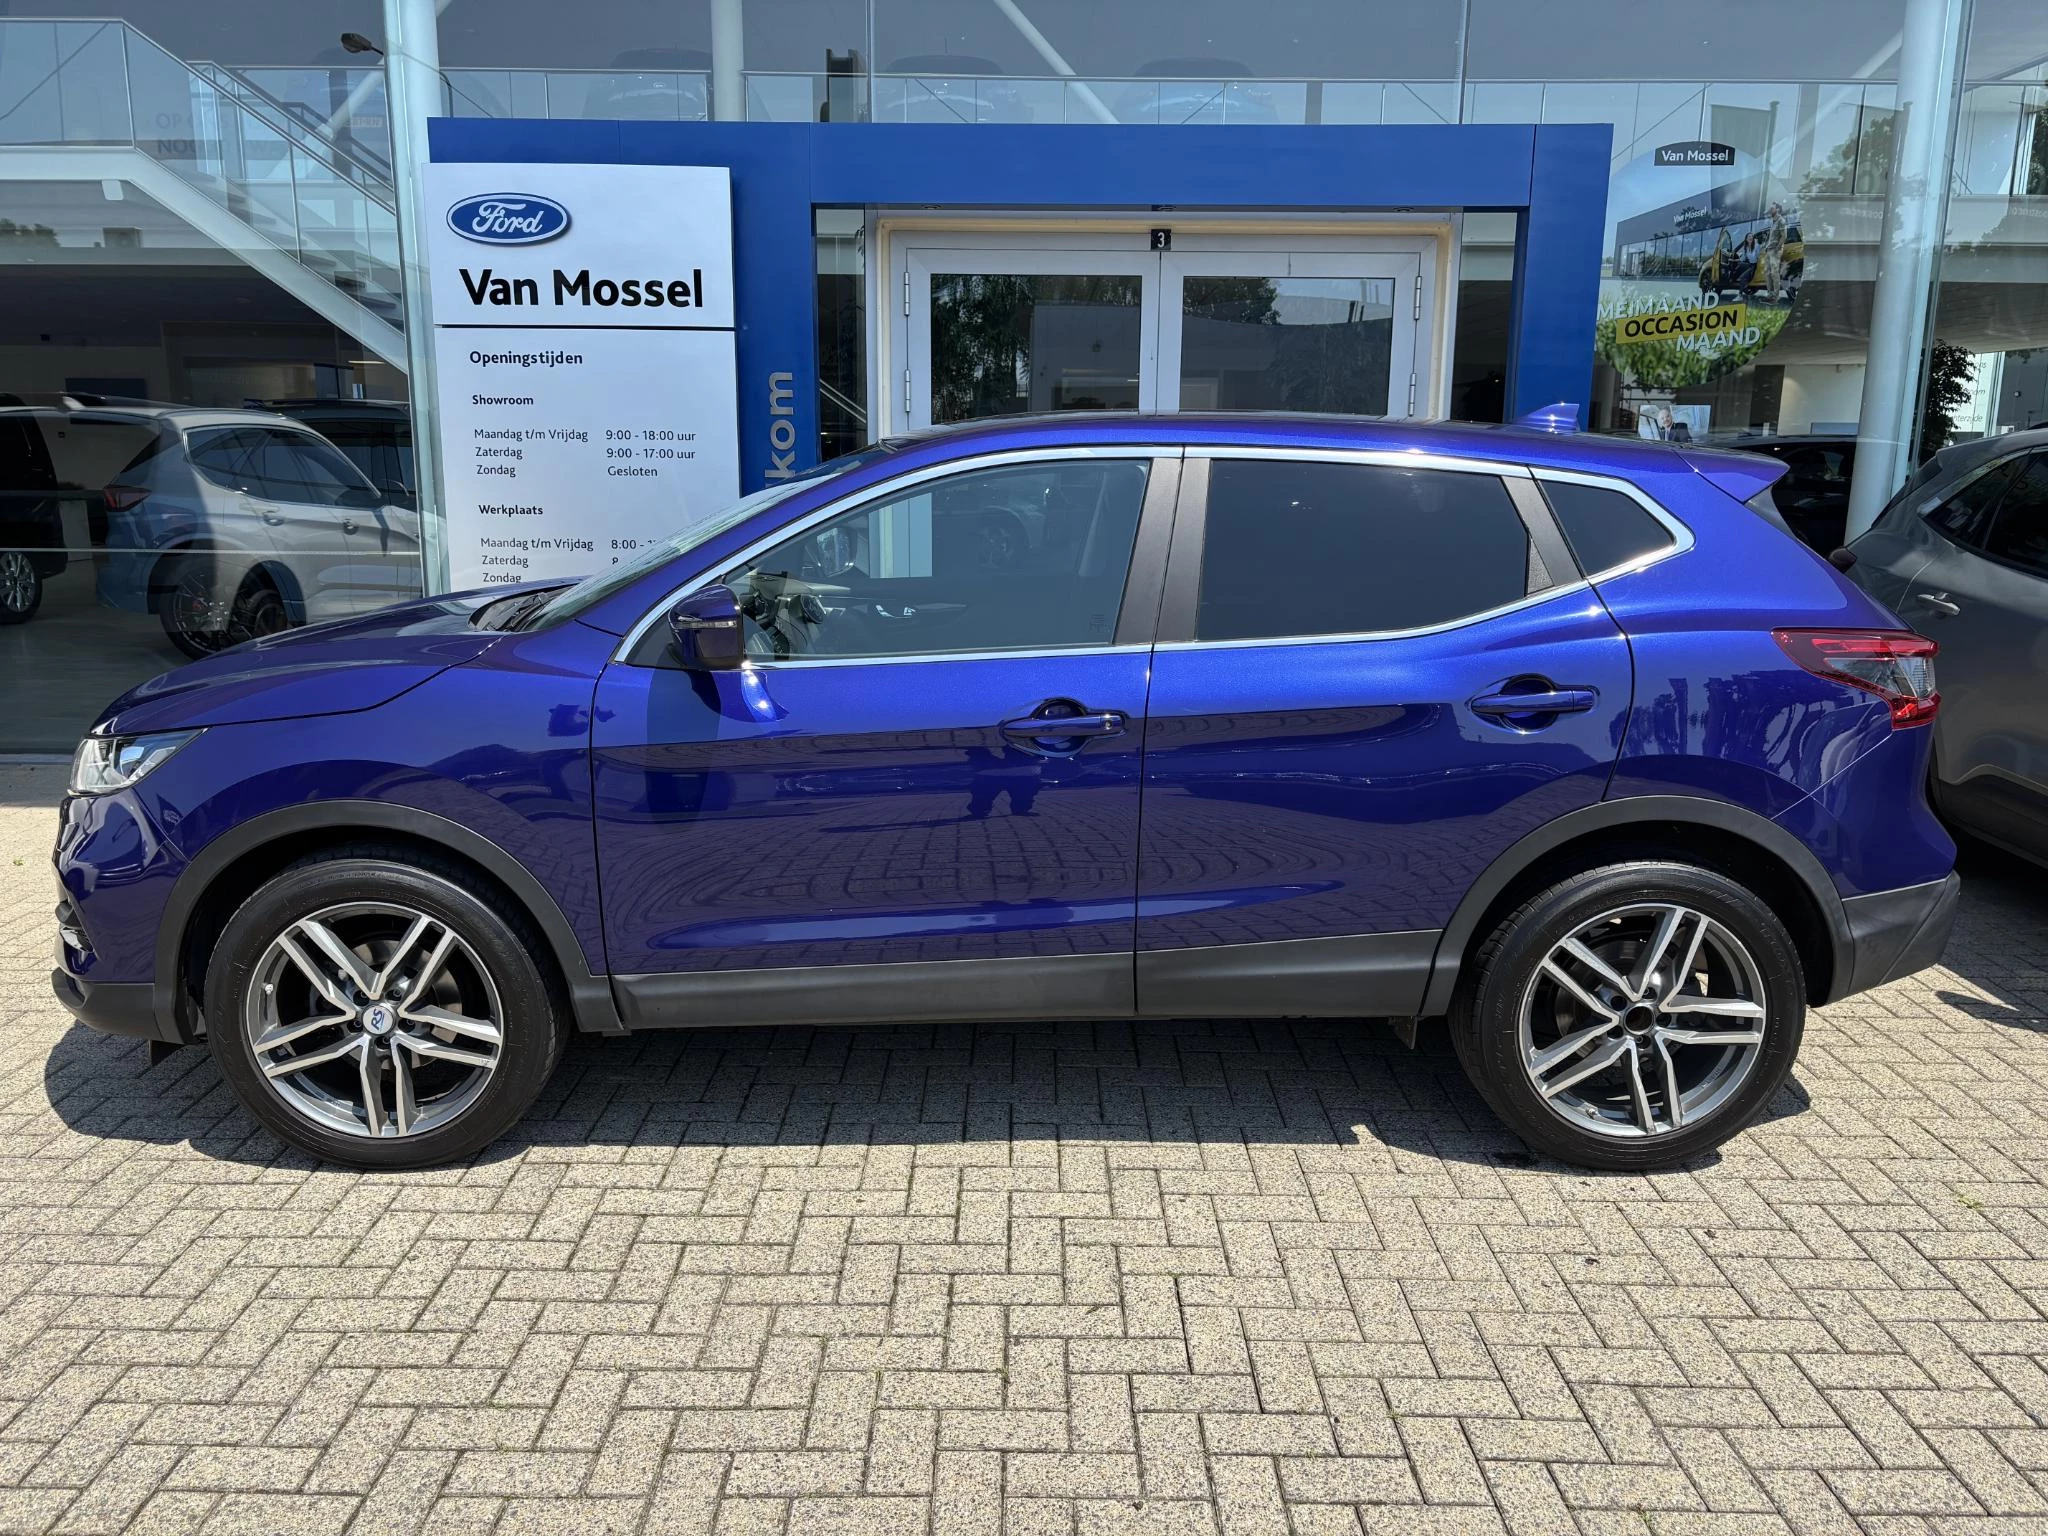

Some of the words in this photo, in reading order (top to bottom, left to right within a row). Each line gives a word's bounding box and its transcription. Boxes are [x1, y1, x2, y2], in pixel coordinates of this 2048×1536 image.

[1661, 149, 1684, 162] Van
[1687, 149, 1729, 162] Mossel
[471, 201, 545, 234] Ford
[1684, 205, 1708, 221] Mossel
[1157, 231, 1165, 248] 3
[458, 268, 540, 306] Van
[552, 268, 704, 309] Mossel
[1624, 309, 1738, 338] OCCASION
[1675, 326, 1761, 352] MAAND
[469, 350, 584, 369] Openingstijden
[471, 394, 535, 407] Showroom
[474, 428, 523, 442] Maandag
[525, 428, 546, 441] t/m
[548, 429, 589, 443] Vrijdag
[605, 429, 632, 442] 9:00
[642, 429, 674, 442] 18:00
[677, 431, 697, 443] uur
[765, 371, 796, 488] kom
[475, 446, 524, 461] Zaterdag
[606, 447, 633, 460] 9:00
[643, 447, 674, 460] 17:00
[677, 450, 696, 460] uur
[476, 463, 517, 478] Zondag
[607, 465, 658, 477] Gesloten
[478, 504, 544, 518] Werkplaats
[480, 537, 529, 551] Maandag
[531, 538, 552, 550] t/m
[554, 538, 594, 552] Vrijdag
[611, 539, 637, 550] 8:00
[482, 555, 529, 569] Zaterdag
[482, 572, 522, 583] Zondag
